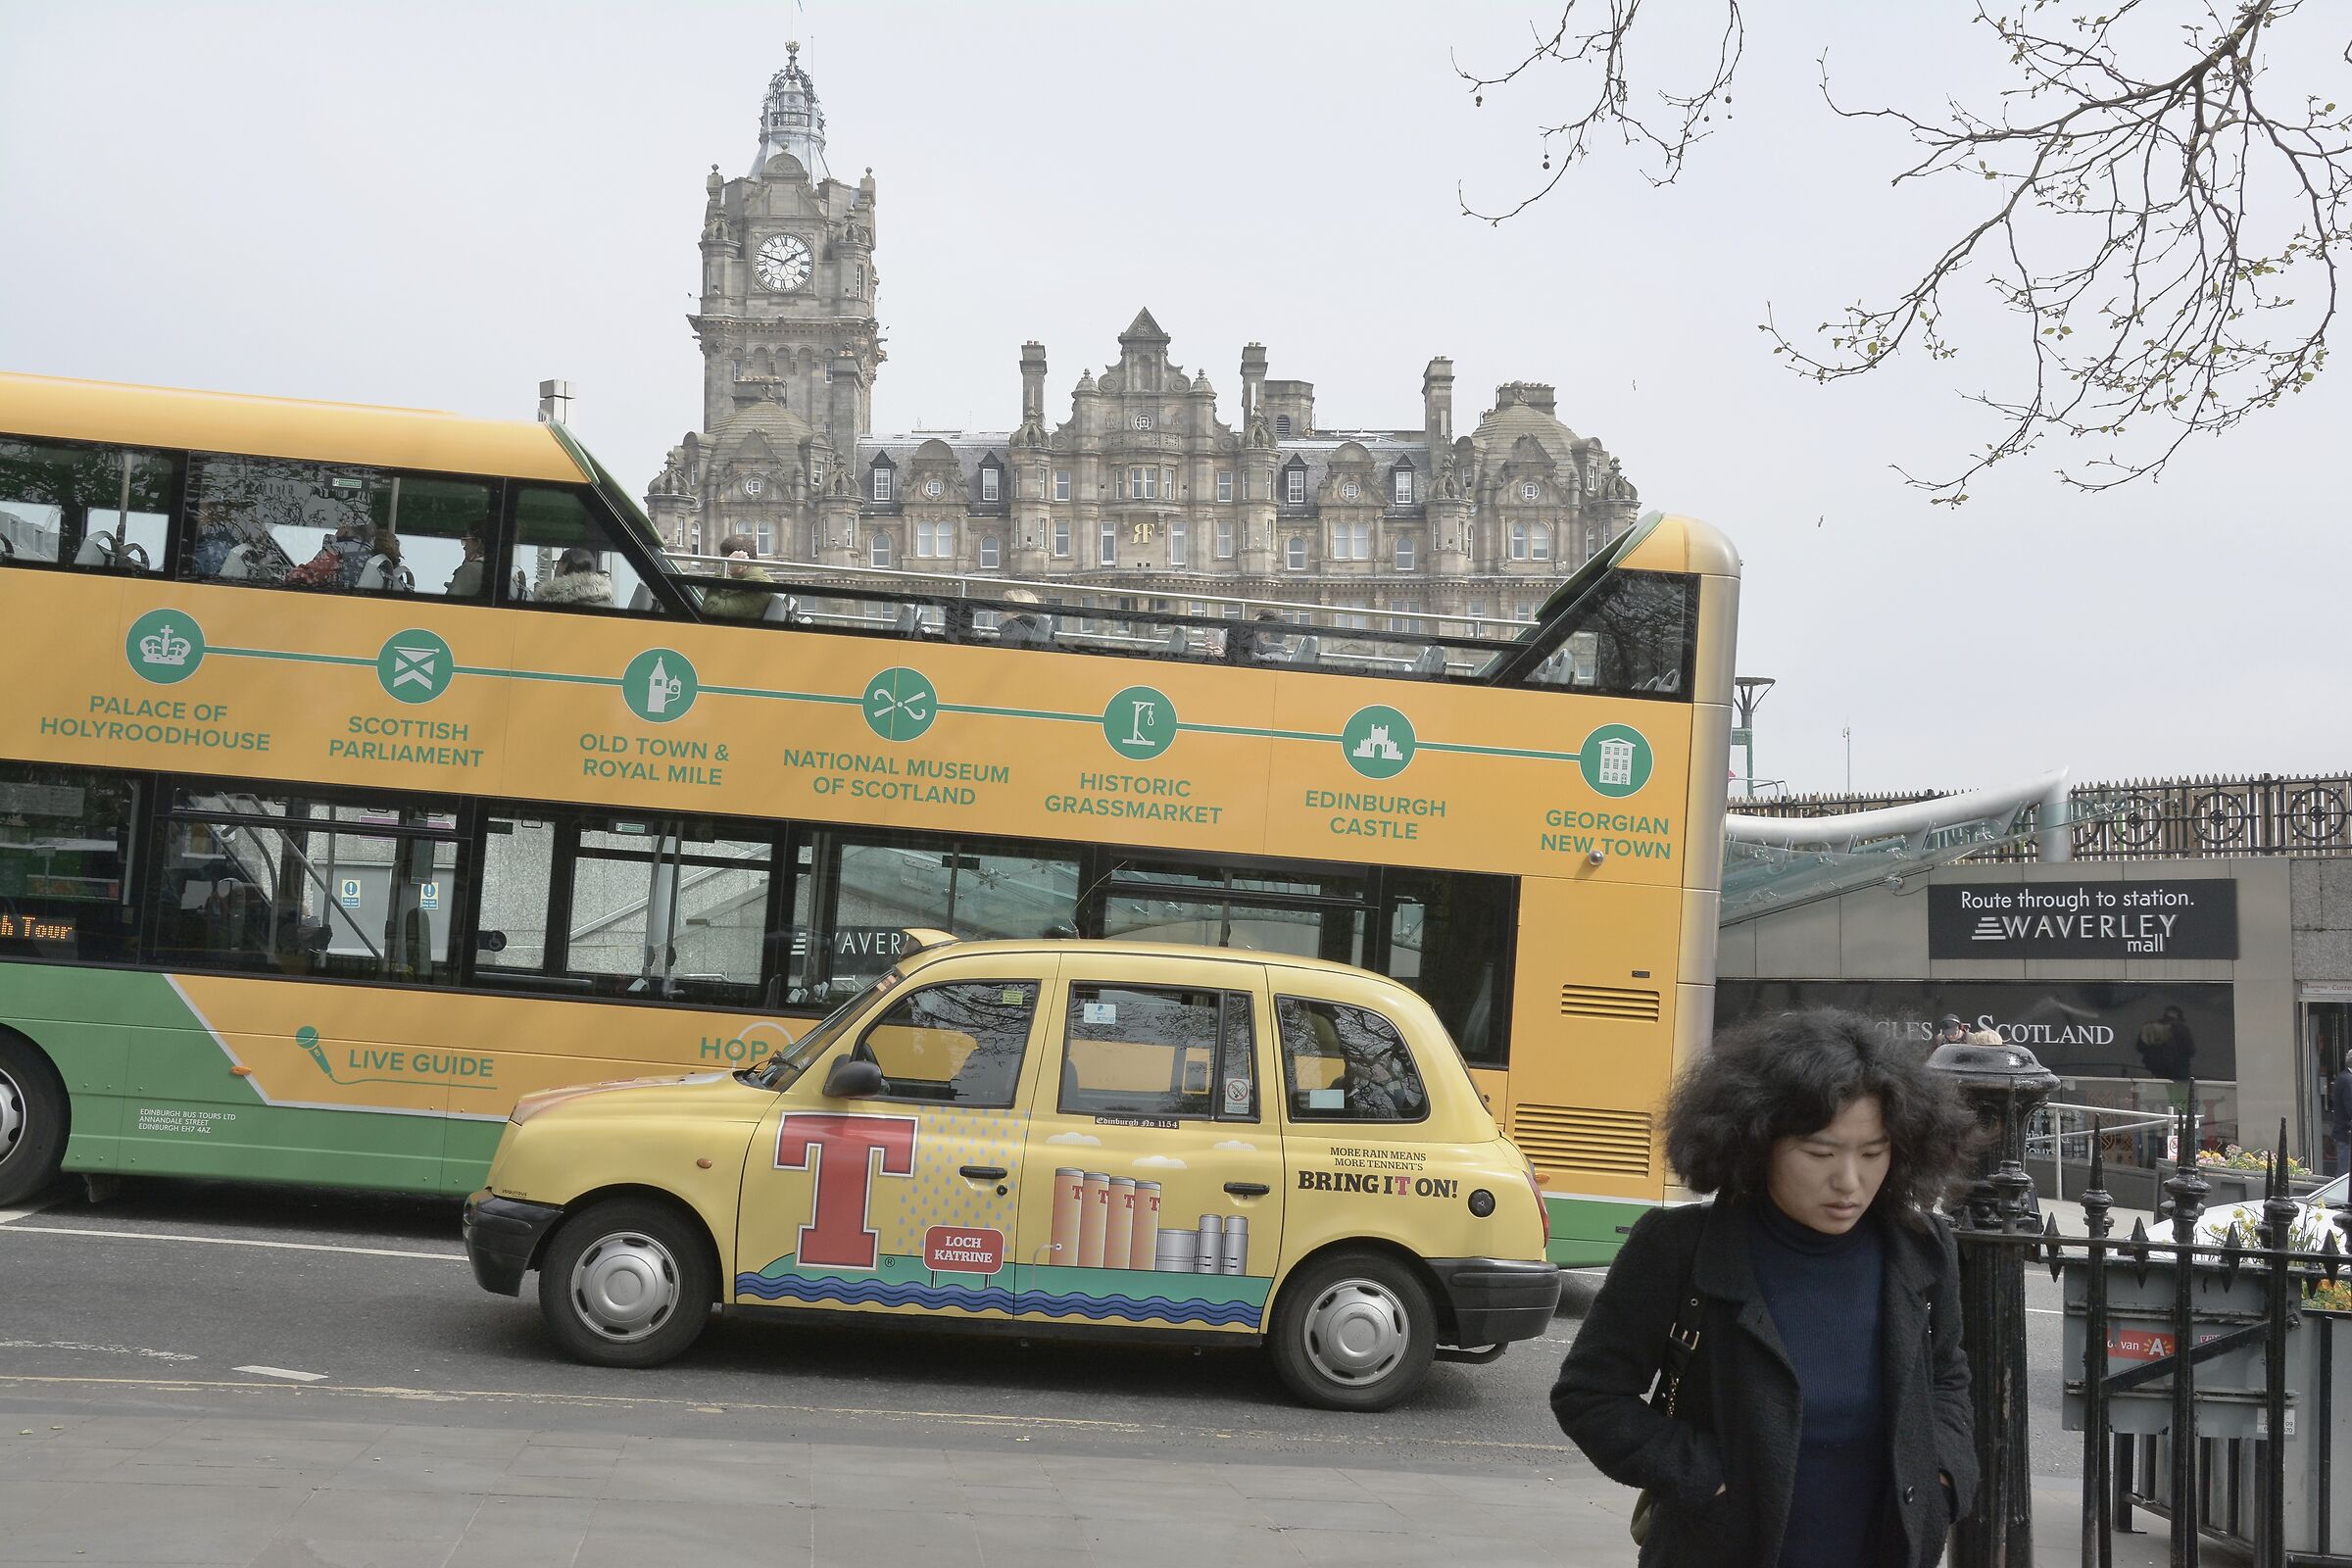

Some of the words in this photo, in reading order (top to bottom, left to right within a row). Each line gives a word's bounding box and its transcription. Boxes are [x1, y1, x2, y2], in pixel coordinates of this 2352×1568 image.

[89, 695, 186, 719] PALACE
[193, 704, 228, 722] OF
[40, 716, 270, 752] HOLYROODHOUSE
[348, 715, 468, 742] SCOTTISH
[329, 739, 484, 767] PARLIAMENT
[580, 733, 628, 754] OLD
[636, 737, 708, 760] TOWN
[714, 744, 729, 761] &
[583, 759, 660, 781] ROYAL
[667, 764, 722, 786] MILE
[784, 749, 900, 775] NATIONAL
[906, 759, 1009, 784] MUSEUM
[813, 776, 845, 795] OF
[851, 779, 976, 806] SCOTLAND
[1080, 772, 1192, 798] HISTORIC
[1045, 795, 1223, 824] GRASSMARKET
[1305, 790, 1446, 817] EDINBURGH
[1330, 816, 1418, 840] CASTLE
[1545, 809, 1669, 835] GEORGIAN
[1541, 833, 1594, 854] NEW
[1601, 838, 1671, 859] TOWN
[1961, 891, 2012, 908] Route
[2017, 888, 2089, 911] through
[2095, 890, 2117, 906] to
[2123, 889, 2195, 906] station.
[22, 916, 74, 940] Tour
[2001, 914, 2180, 938] WAVERLEY
[835, 933, 902, 955] AVER
[2128, 933, 2164, 952] mall
[700, 1037, 769, 1062] HOP
[349, 1050, 405, 1071] LIVE
[413, 1054, 494, 1078] GUIDE
[138, 1116, 183, 1125] ANNANDALE
[140, 1108, 180, 1117] EDINBURGH
[1096, 1117, 1139, 1127] Edinburgh
[1158, 1120, 1178, 1129] 1154
[138, 1123, 179, 1132] EDINBURGH
[1330, 1147, 1361, 1156] MORE
[1362, 1149, 1389, 1159] RAIN
[1390, 1151, 1427, 1161] MEANS
[1335, 1157, 1365, 1168] MORE
[1366, 1160, 1424, 1171] TENNENT'S
[774, 1111, 918, 1270] T
[1298, 1170, 1379, 1194] BRING
[1383, 1176, 1411, 1196] IT
[1415, 1178, 1458, 1199] ON!
[945, 1236, 982, 1249] LOCH
[934, 1250, 993, 1263] KATRINE
[2121, 1340, 2139, 1351] van
